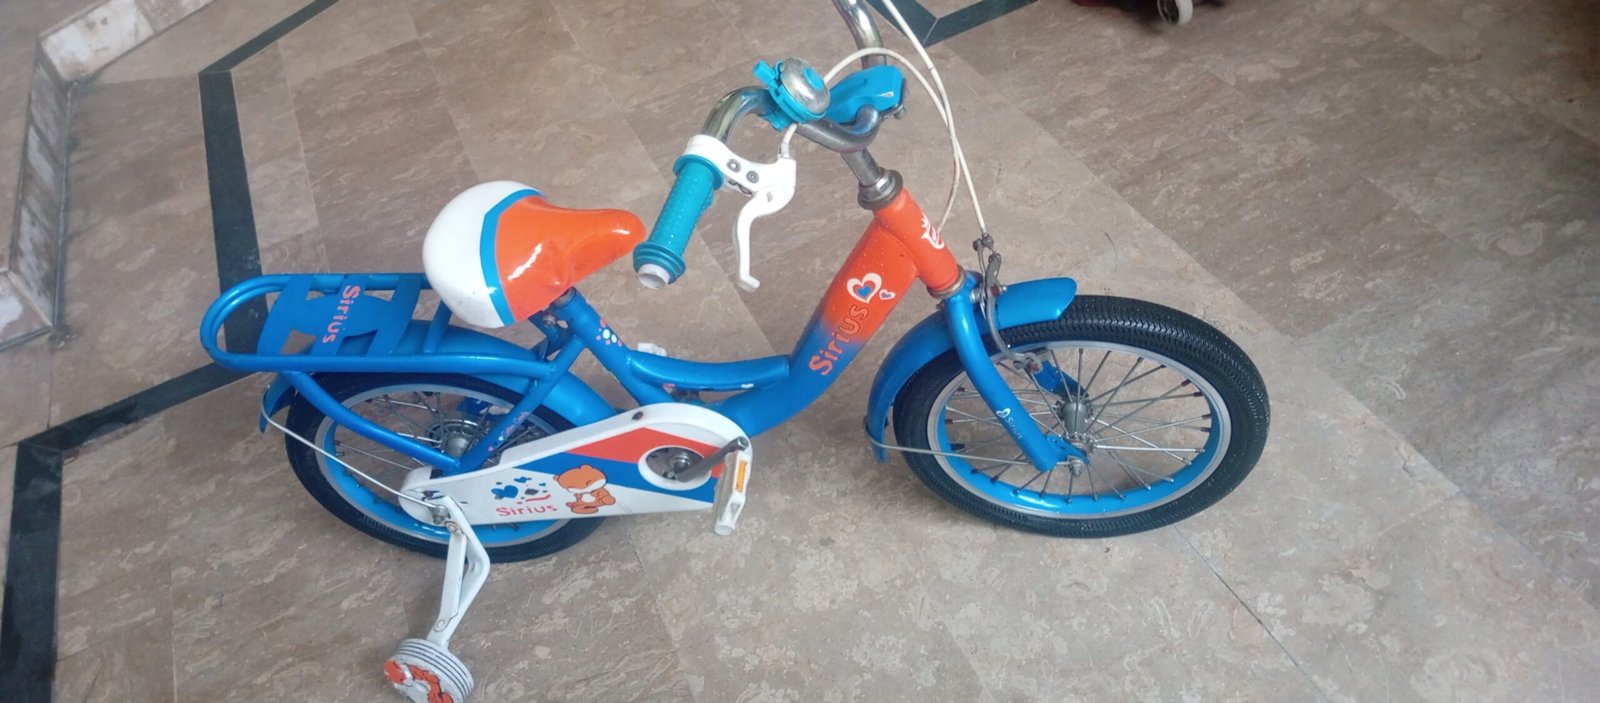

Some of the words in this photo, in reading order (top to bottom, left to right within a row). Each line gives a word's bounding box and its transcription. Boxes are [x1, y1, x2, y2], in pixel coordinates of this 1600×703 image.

[322, 285, 361, 344] Sirius
[808, 305, 869, 376] Sirius
[495, 504, 558, 517] Sirius
